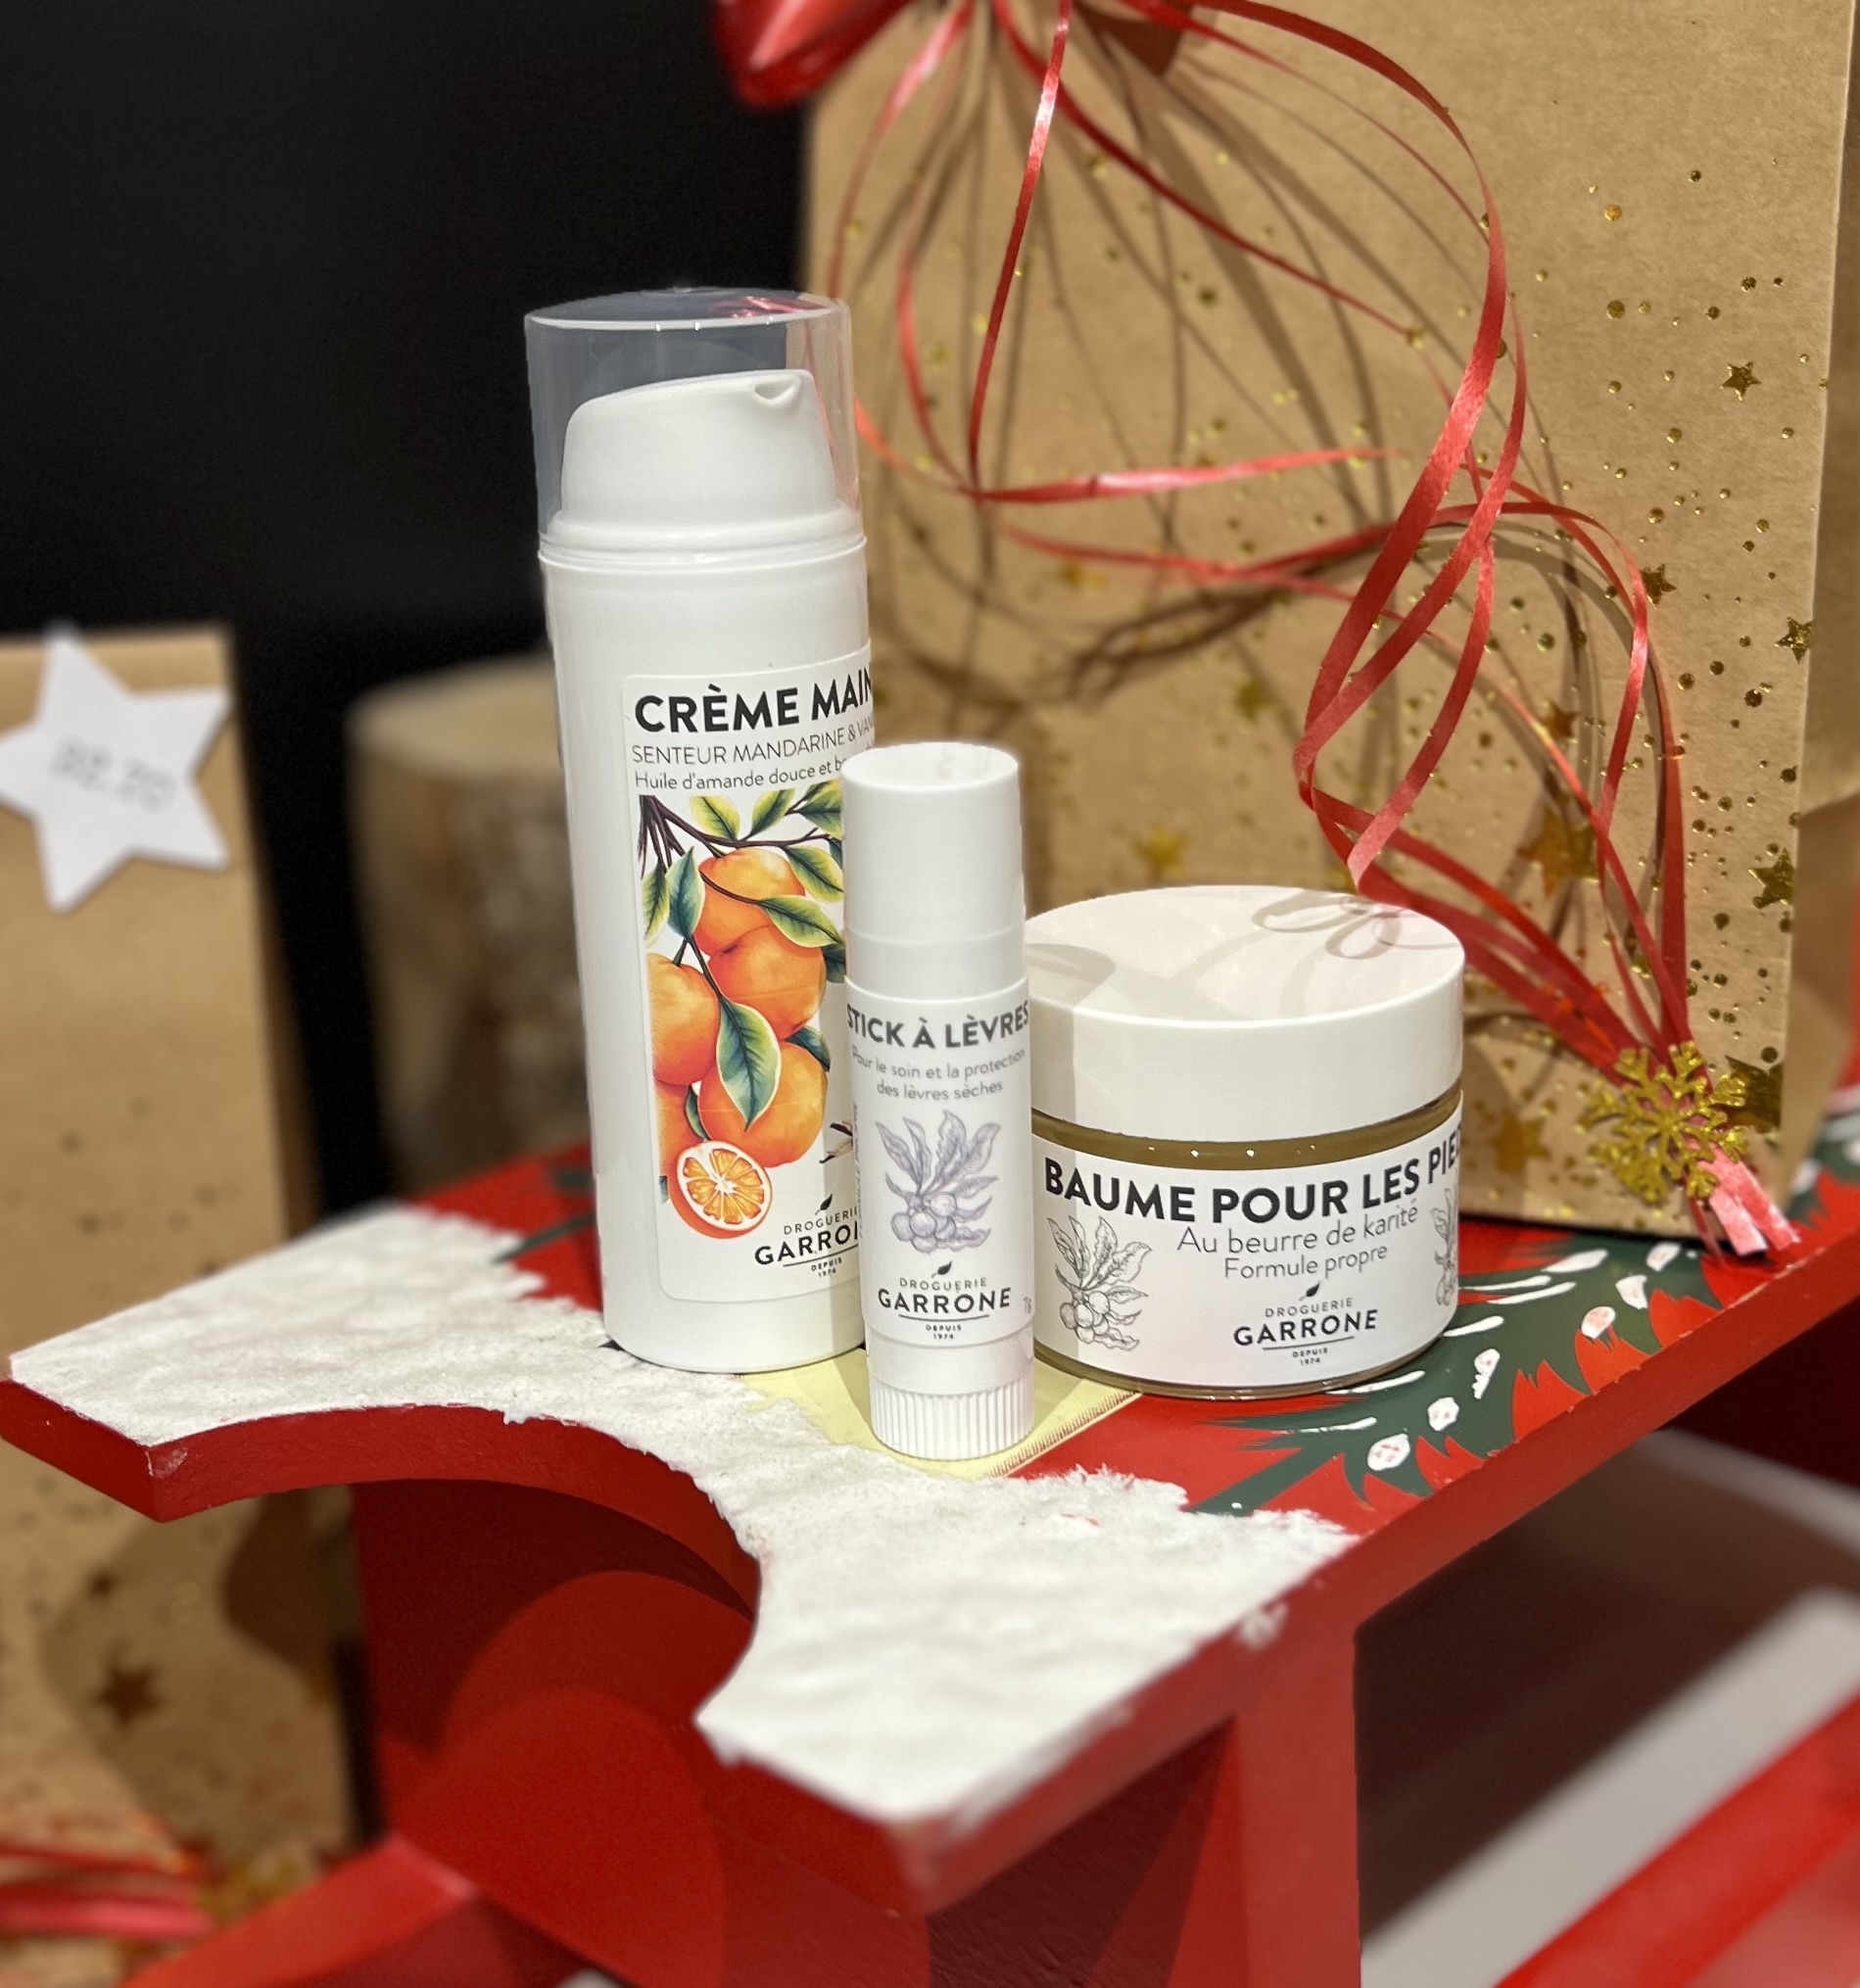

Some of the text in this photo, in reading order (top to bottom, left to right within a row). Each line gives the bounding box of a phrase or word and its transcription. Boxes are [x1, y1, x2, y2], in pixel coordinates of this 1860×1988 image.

[635, 684, 799, 733] CRÈME
[632, 744, 727, 765] SENTEUR
[734, 728, 844, 763] MANDARINE
[847, 724, 856, 742] &
[635, 771, 677, 789] Huile
[683, 771, 764, 789] d'amande
[769, 767, 816, 784] douce
[819, 759, 832, 776] et
[847, 1000, 1028, 1049] STICK À LÈVRES
[852, 1045, 1025, 1081] Pour le soin et la protection
[877, 1079, 1003, 1101] des lèvres sèches
[1045, 1158, 1195, 1222] BAUME
[1213, 1179, 1348, 1223] POUR
[1362, 1159, 1419, 1209] LES
[1176, 1198, 1418, 1254] Au beurre de karité
[811, 1257, 842, 1271] DEPUIS
[1225, 1245, 1388, 1279] Formule propre
[878, 1288, 1011, 1313] GARRONE
[899, 1277, 987, 1292] DROGUERIE
[1264, 1298, 1353, 1318] DROGUERIE
[1233, 1309, 1378, 1346] GARRONE
[1292, 1347, 1328, 1358] DEPUIS
